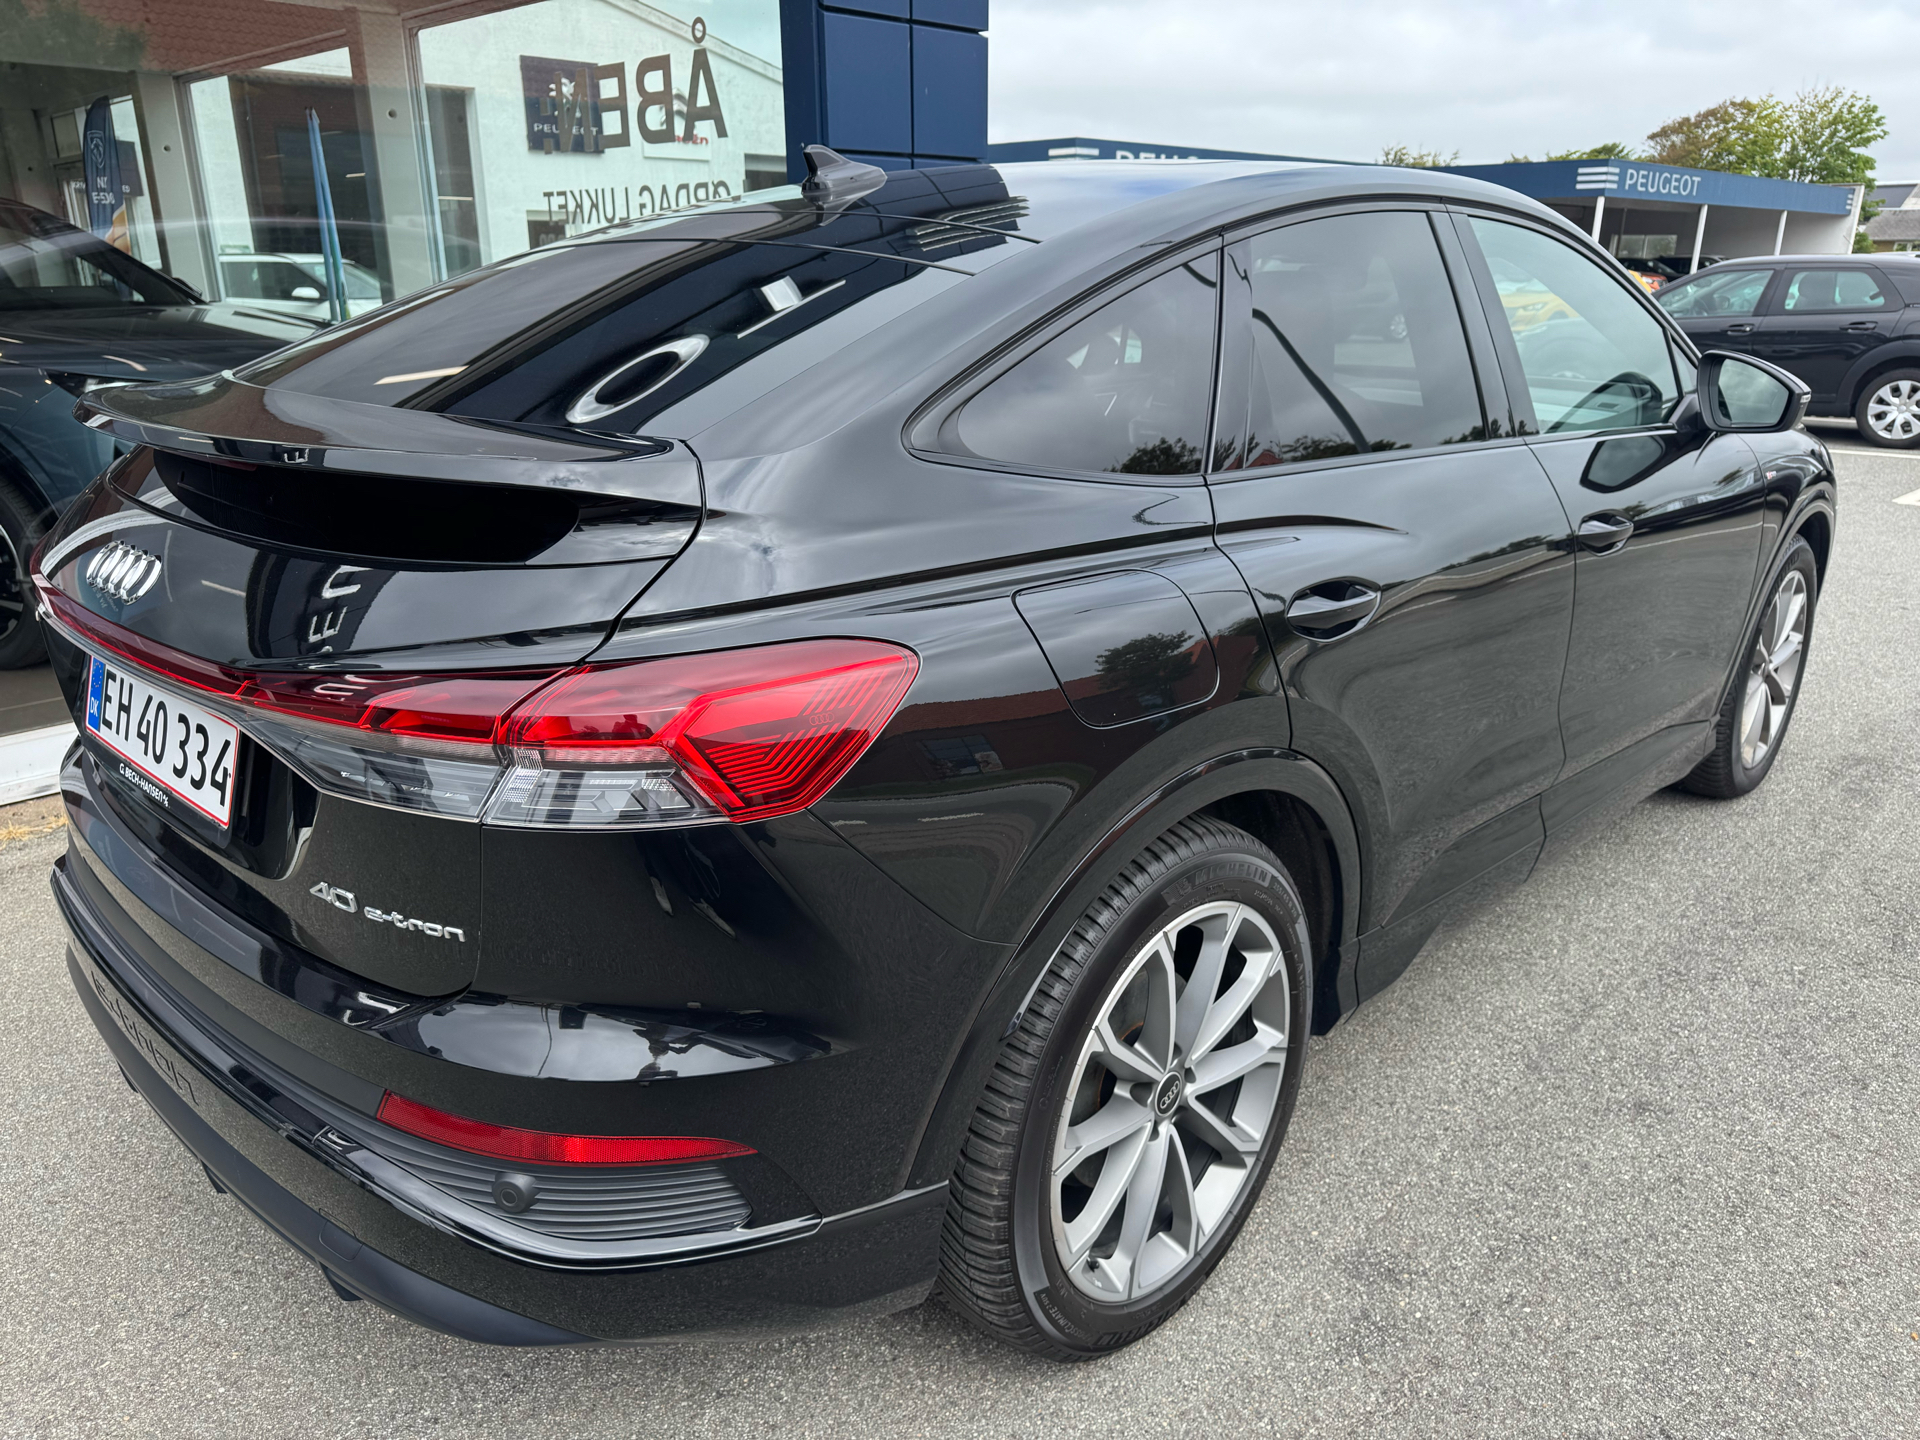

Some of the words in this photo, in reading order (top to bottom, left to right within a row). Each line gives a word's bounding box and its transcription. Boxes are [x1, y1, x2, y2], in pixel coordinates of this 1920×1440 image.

[533, 123, 599, 136] PEUET
[1625, 169, 1702, 196] PEUGEOT
[89, 695, 99, 718] DK
[101, 669, 134, 742] EH
[137, 693, 168, 765] 40
[172, 712, 232, 808] 334
[1195, 862, 1269, 885] MICHELIN
[309, 881, 358, 914] 40
[363, 905, 466, 943] e-tron
